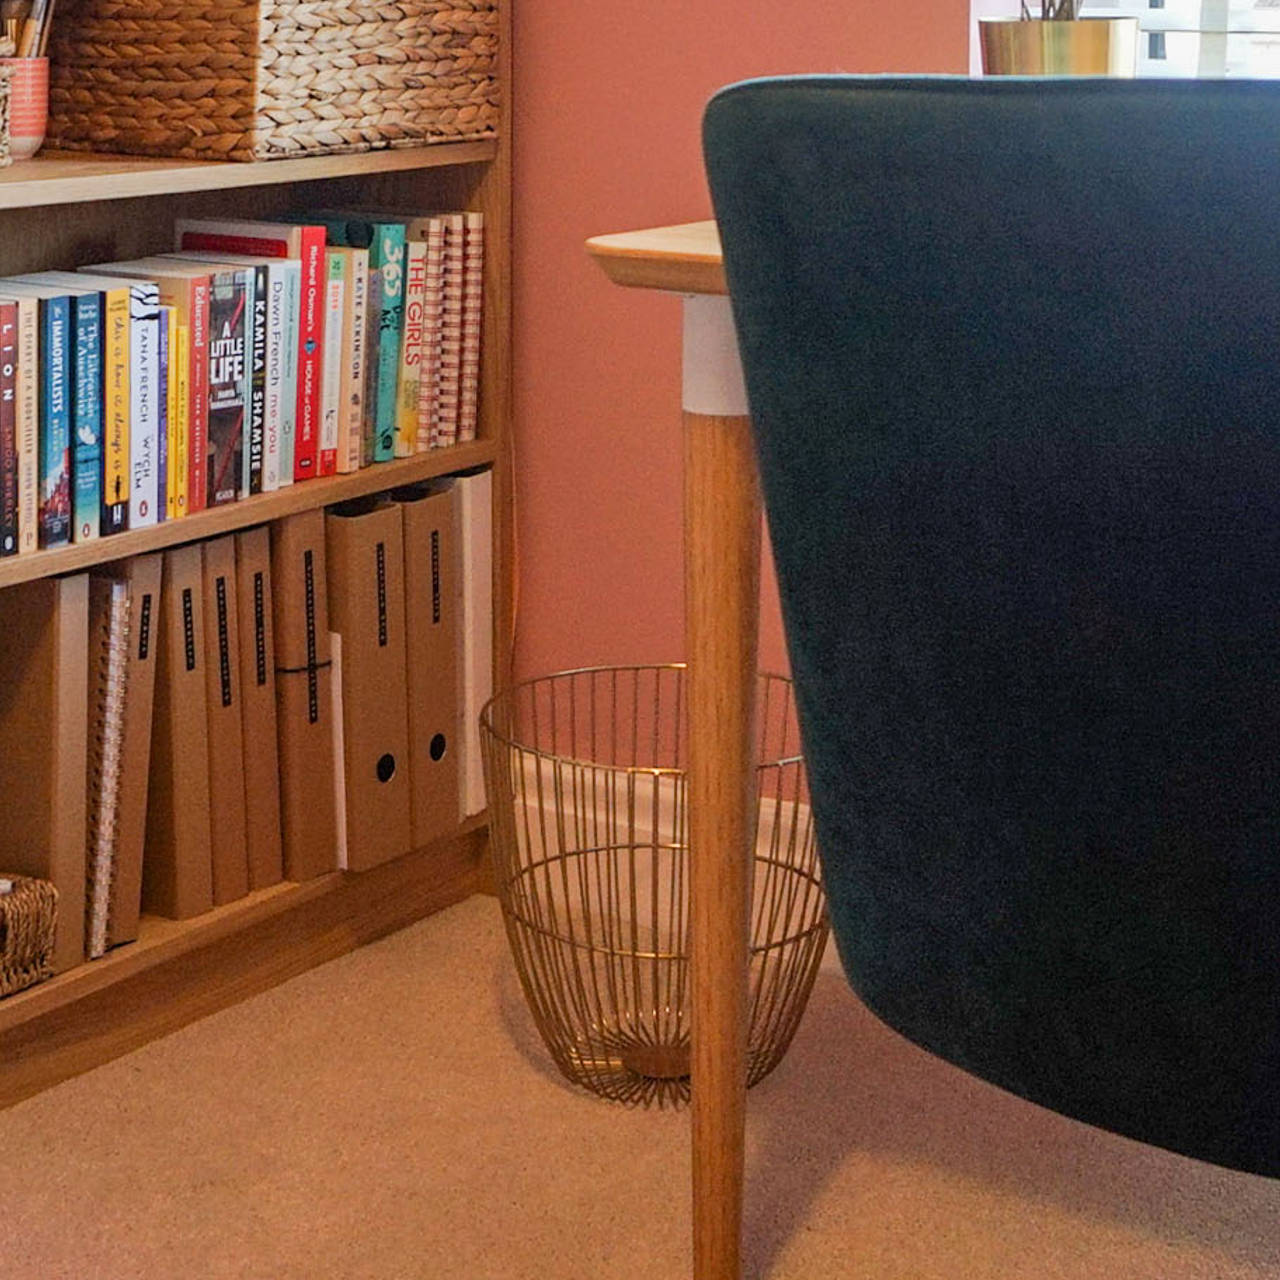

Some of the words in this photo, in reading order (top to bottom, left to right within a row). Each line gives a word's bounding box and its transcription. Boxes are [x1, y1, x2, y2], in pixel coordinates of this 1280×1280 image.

[308, 245, 318, 286] Richard
[354, 277, 363, 308] KATE
[382, 238, 402, 298] 365
[408, 255, 424, 295] THE
[193, 286, 206, 348] Educated
[271, 280, 283, 327] Dawn
[306, 288, 317, 333] Osman's
[78, 327, 86, 339] of
[87, 323, 98, 350] The
[210, 337, 245, 359] LITTLE
[253, 300, 265, 371] KAMILA
[269, 331, 282, 387] French
[352, 314, 363, 381] ATKINSON
[404, 299, 422, 367] GIRLS
[2, 324, 13, 401] LION
[51, 320, 63, 413] IMMORTALISTS
[76, 347, 86, 418] Auschwitz
[86, 355, 98, 418] Librarian
[209, 356, 245, 385] LIFE
[139, 363, 149, 423] FRENCH
[141, 437, 151, 478] WYCH
[251, 391, 264, 471] SHAMSIE
[134, 462, 143, 489] ELM
